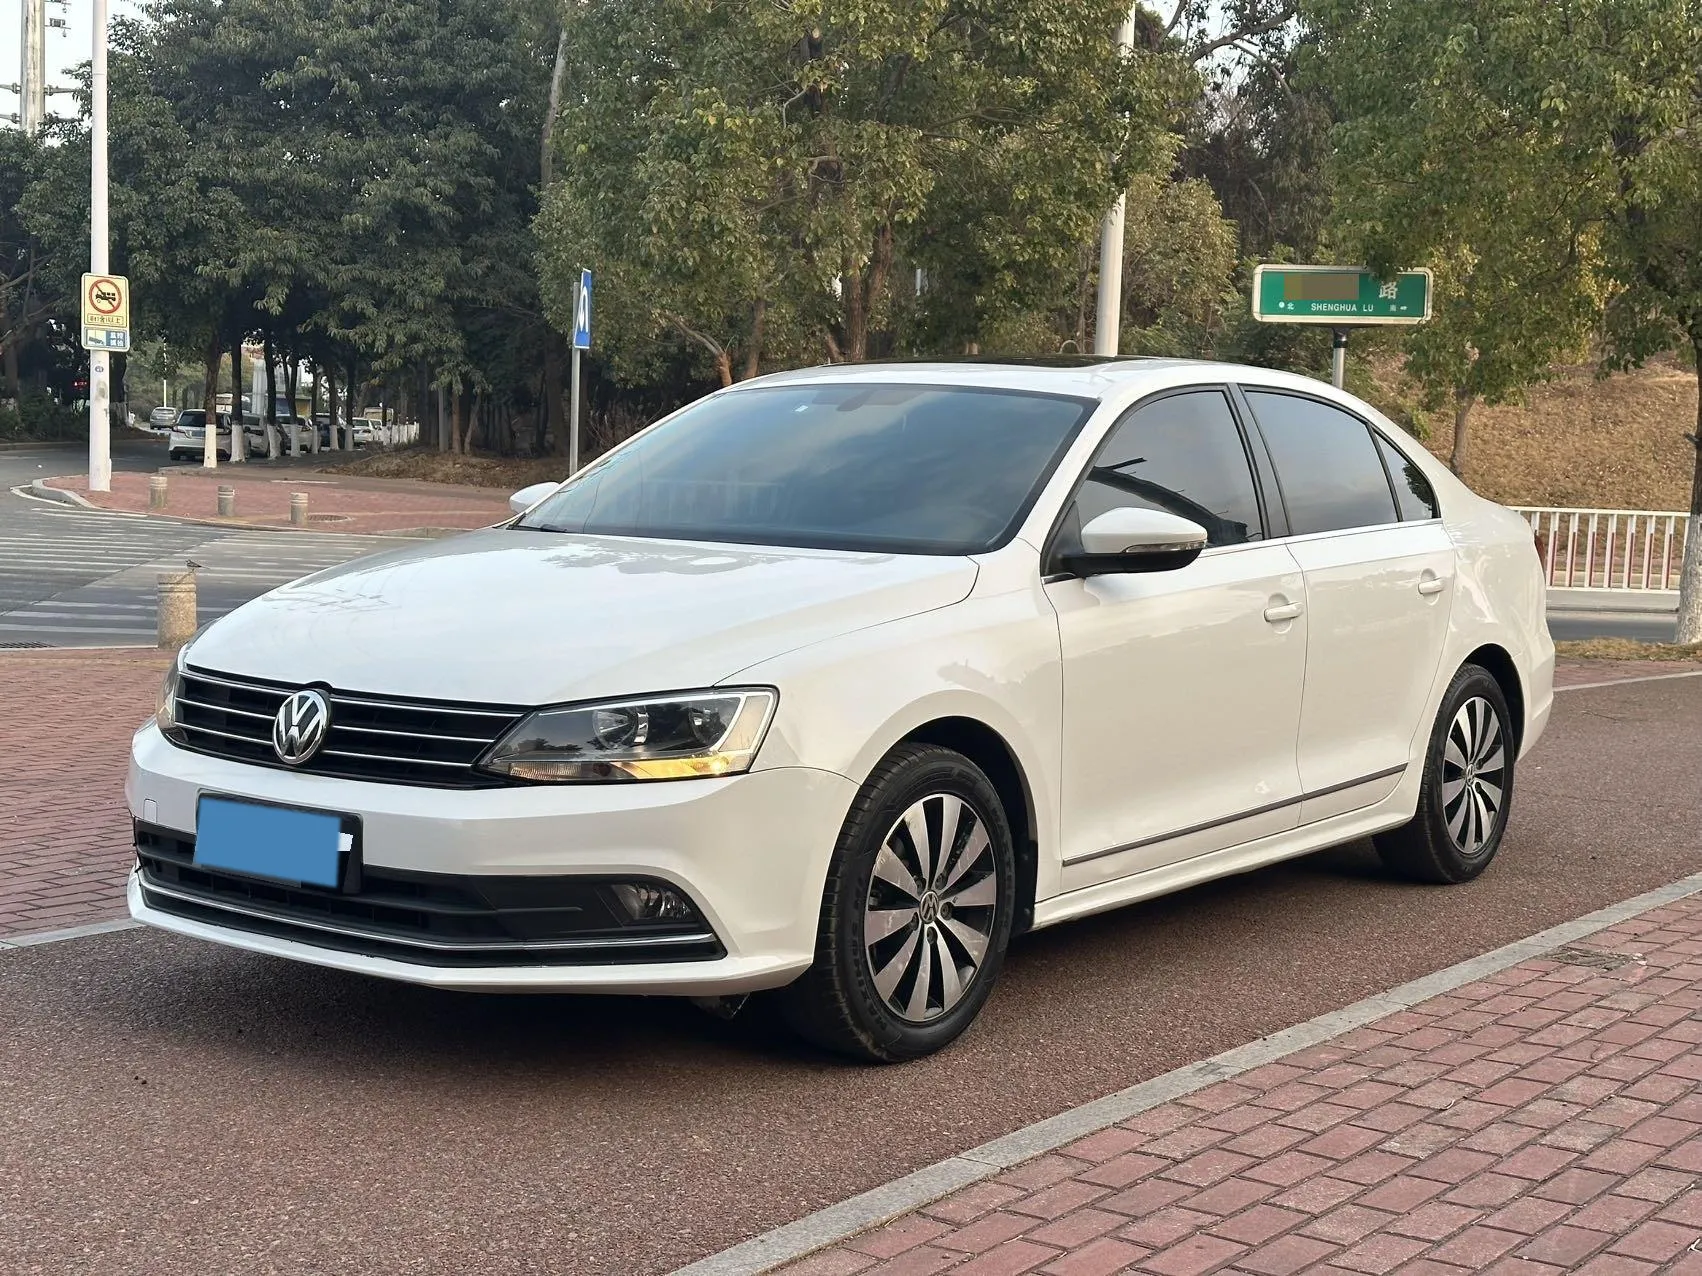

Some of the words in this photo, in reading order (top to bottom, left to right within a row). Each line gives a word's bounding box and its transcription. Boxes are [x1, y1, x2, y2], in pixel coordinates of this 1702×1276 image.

[1379, 281, 1398, 299] 路
[1311, 303, 1357, 312] SHENGHUA
[1363, 303, 1374, 312] LU
